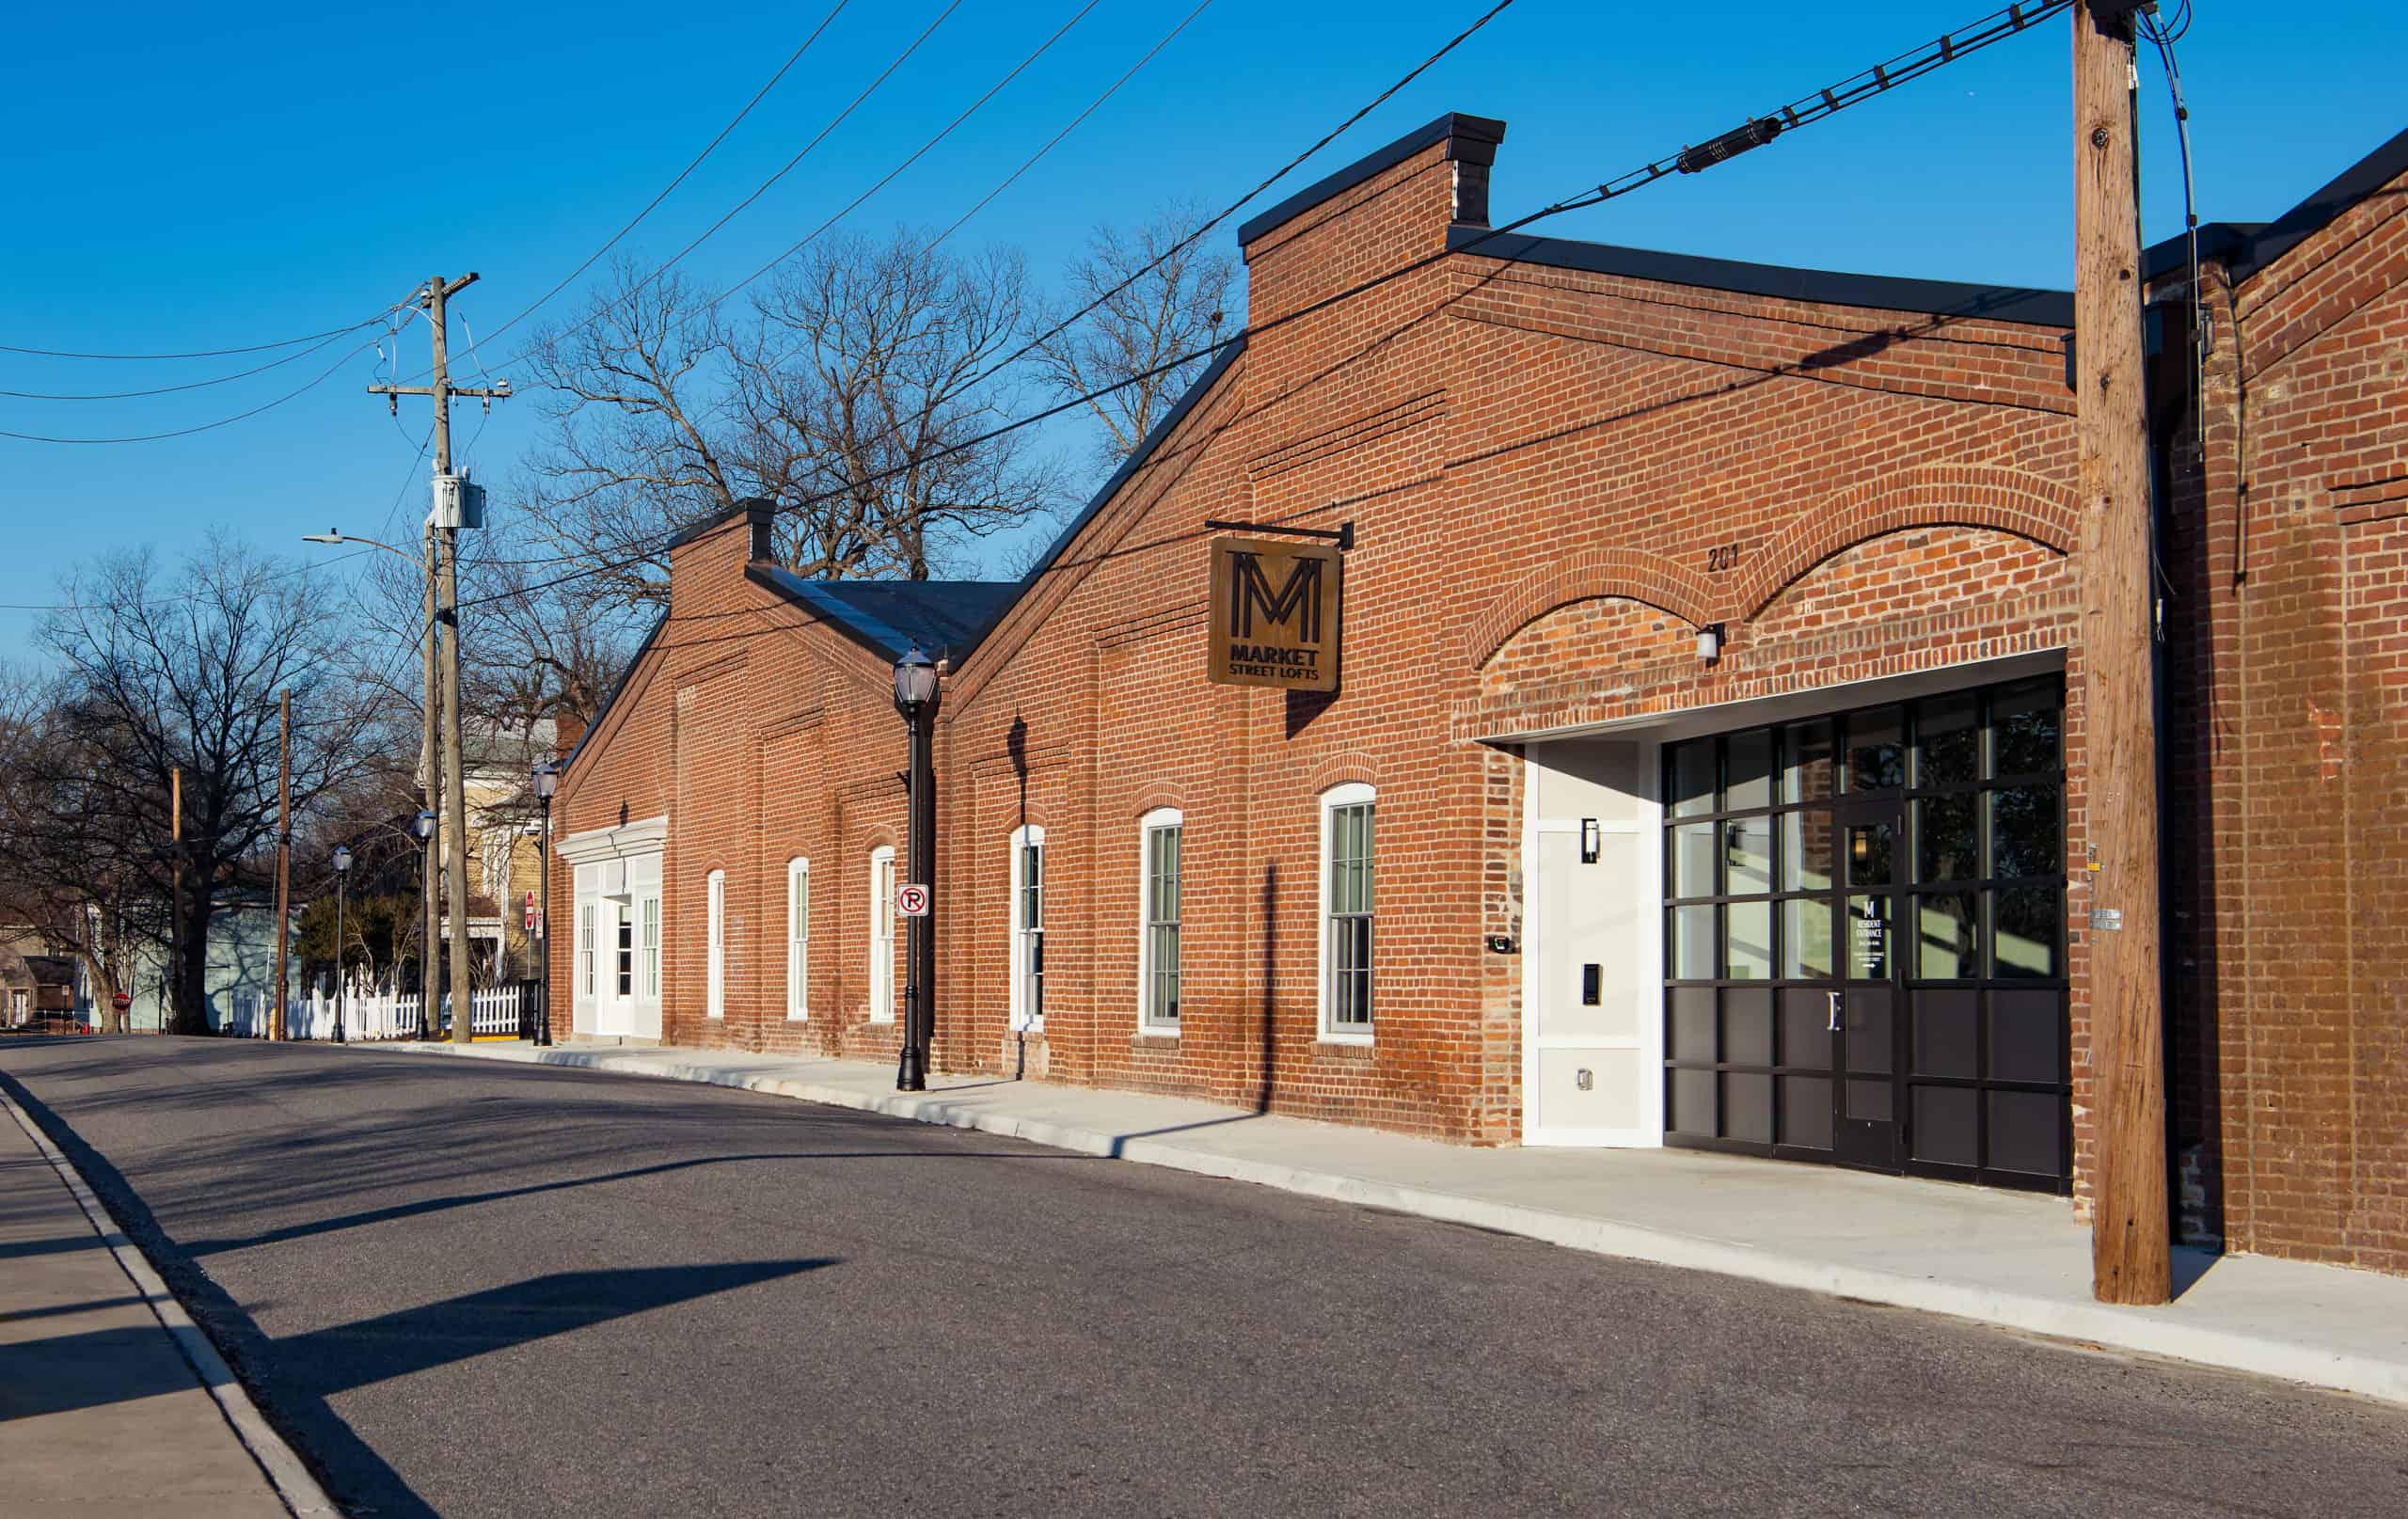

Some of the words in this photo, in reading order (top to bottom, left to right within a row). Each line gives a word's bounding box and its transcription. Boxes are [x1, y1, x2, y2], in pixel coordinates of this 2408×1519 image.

[1708, 543, 1738, 573] 201
[1226, 551, 1328, 643] M
[1230, 645, 1320, 666] MARKET
[1229, 664, 1275, 677] STREET
[1279, 667, 1320, 681] LOFTS
